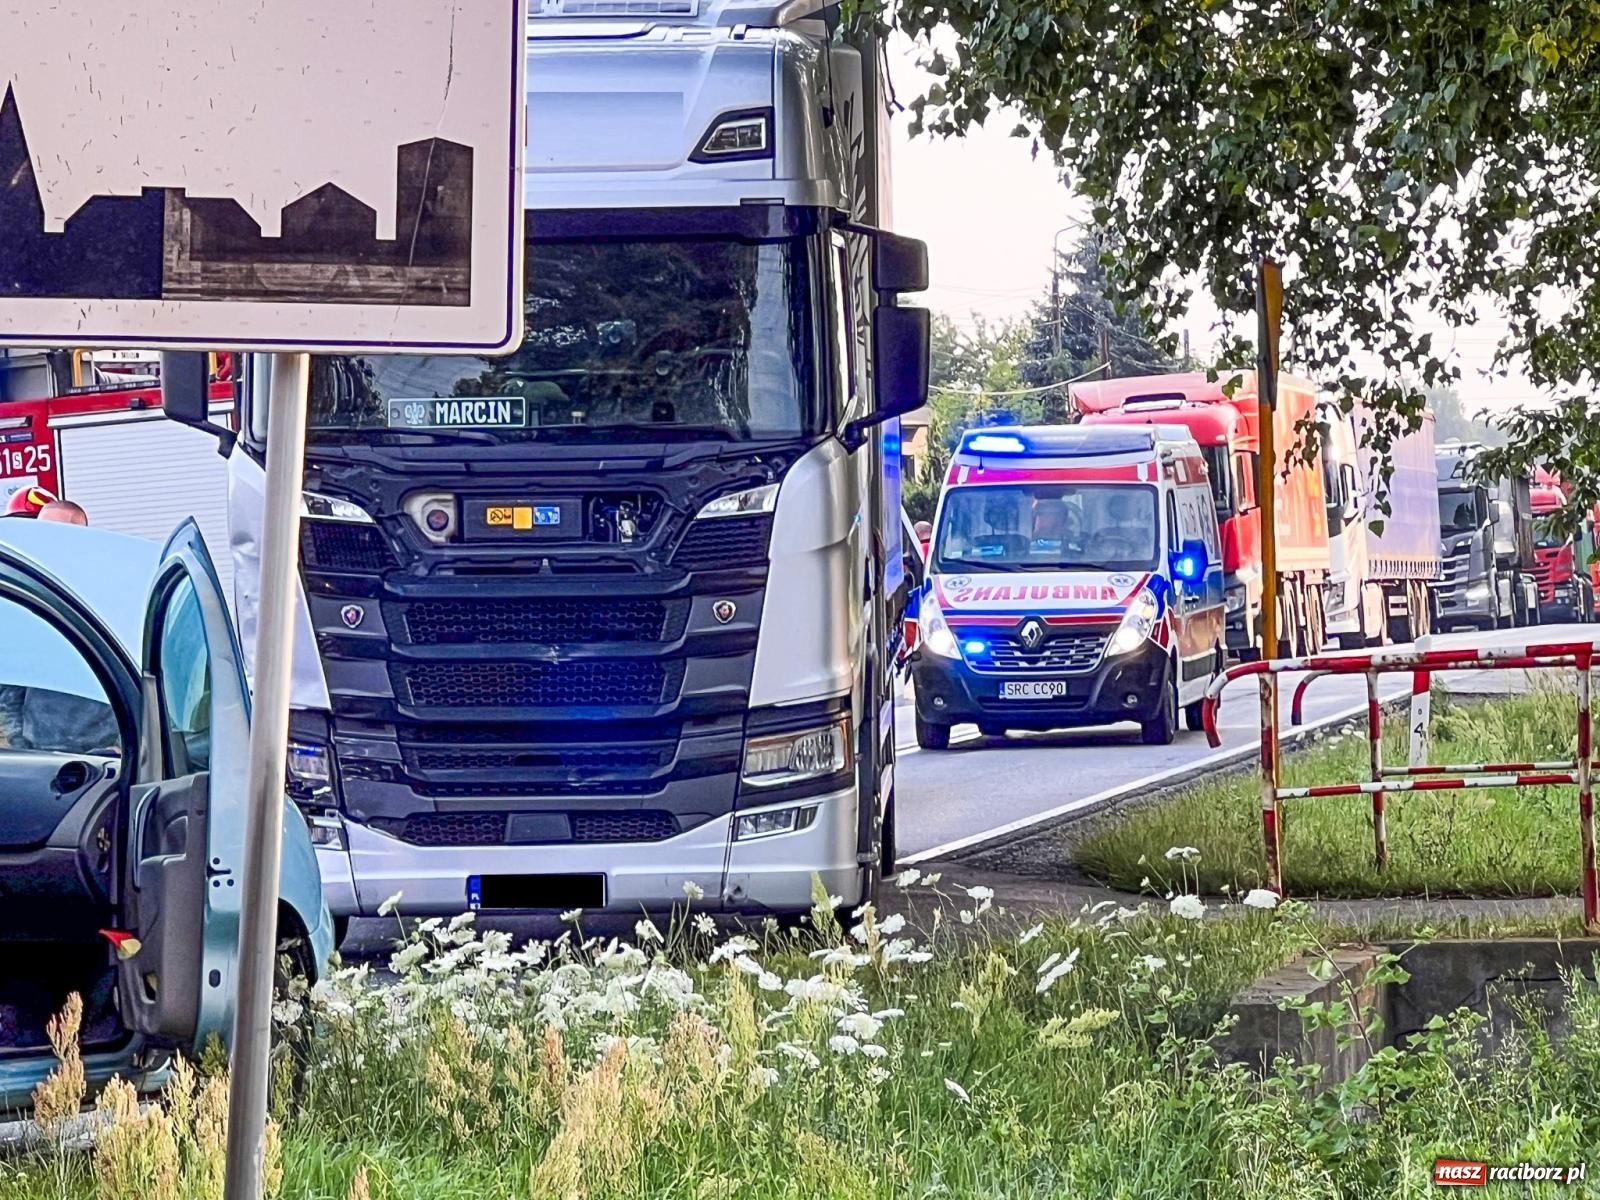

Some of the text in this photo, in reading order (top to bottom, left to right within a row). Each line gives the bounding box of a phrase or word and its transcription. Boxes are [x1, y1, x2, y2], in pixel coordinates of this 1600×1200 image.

[435, 401, 511, 424] MARCIN
[1007, 682, 1064, 696] SRC CC90
